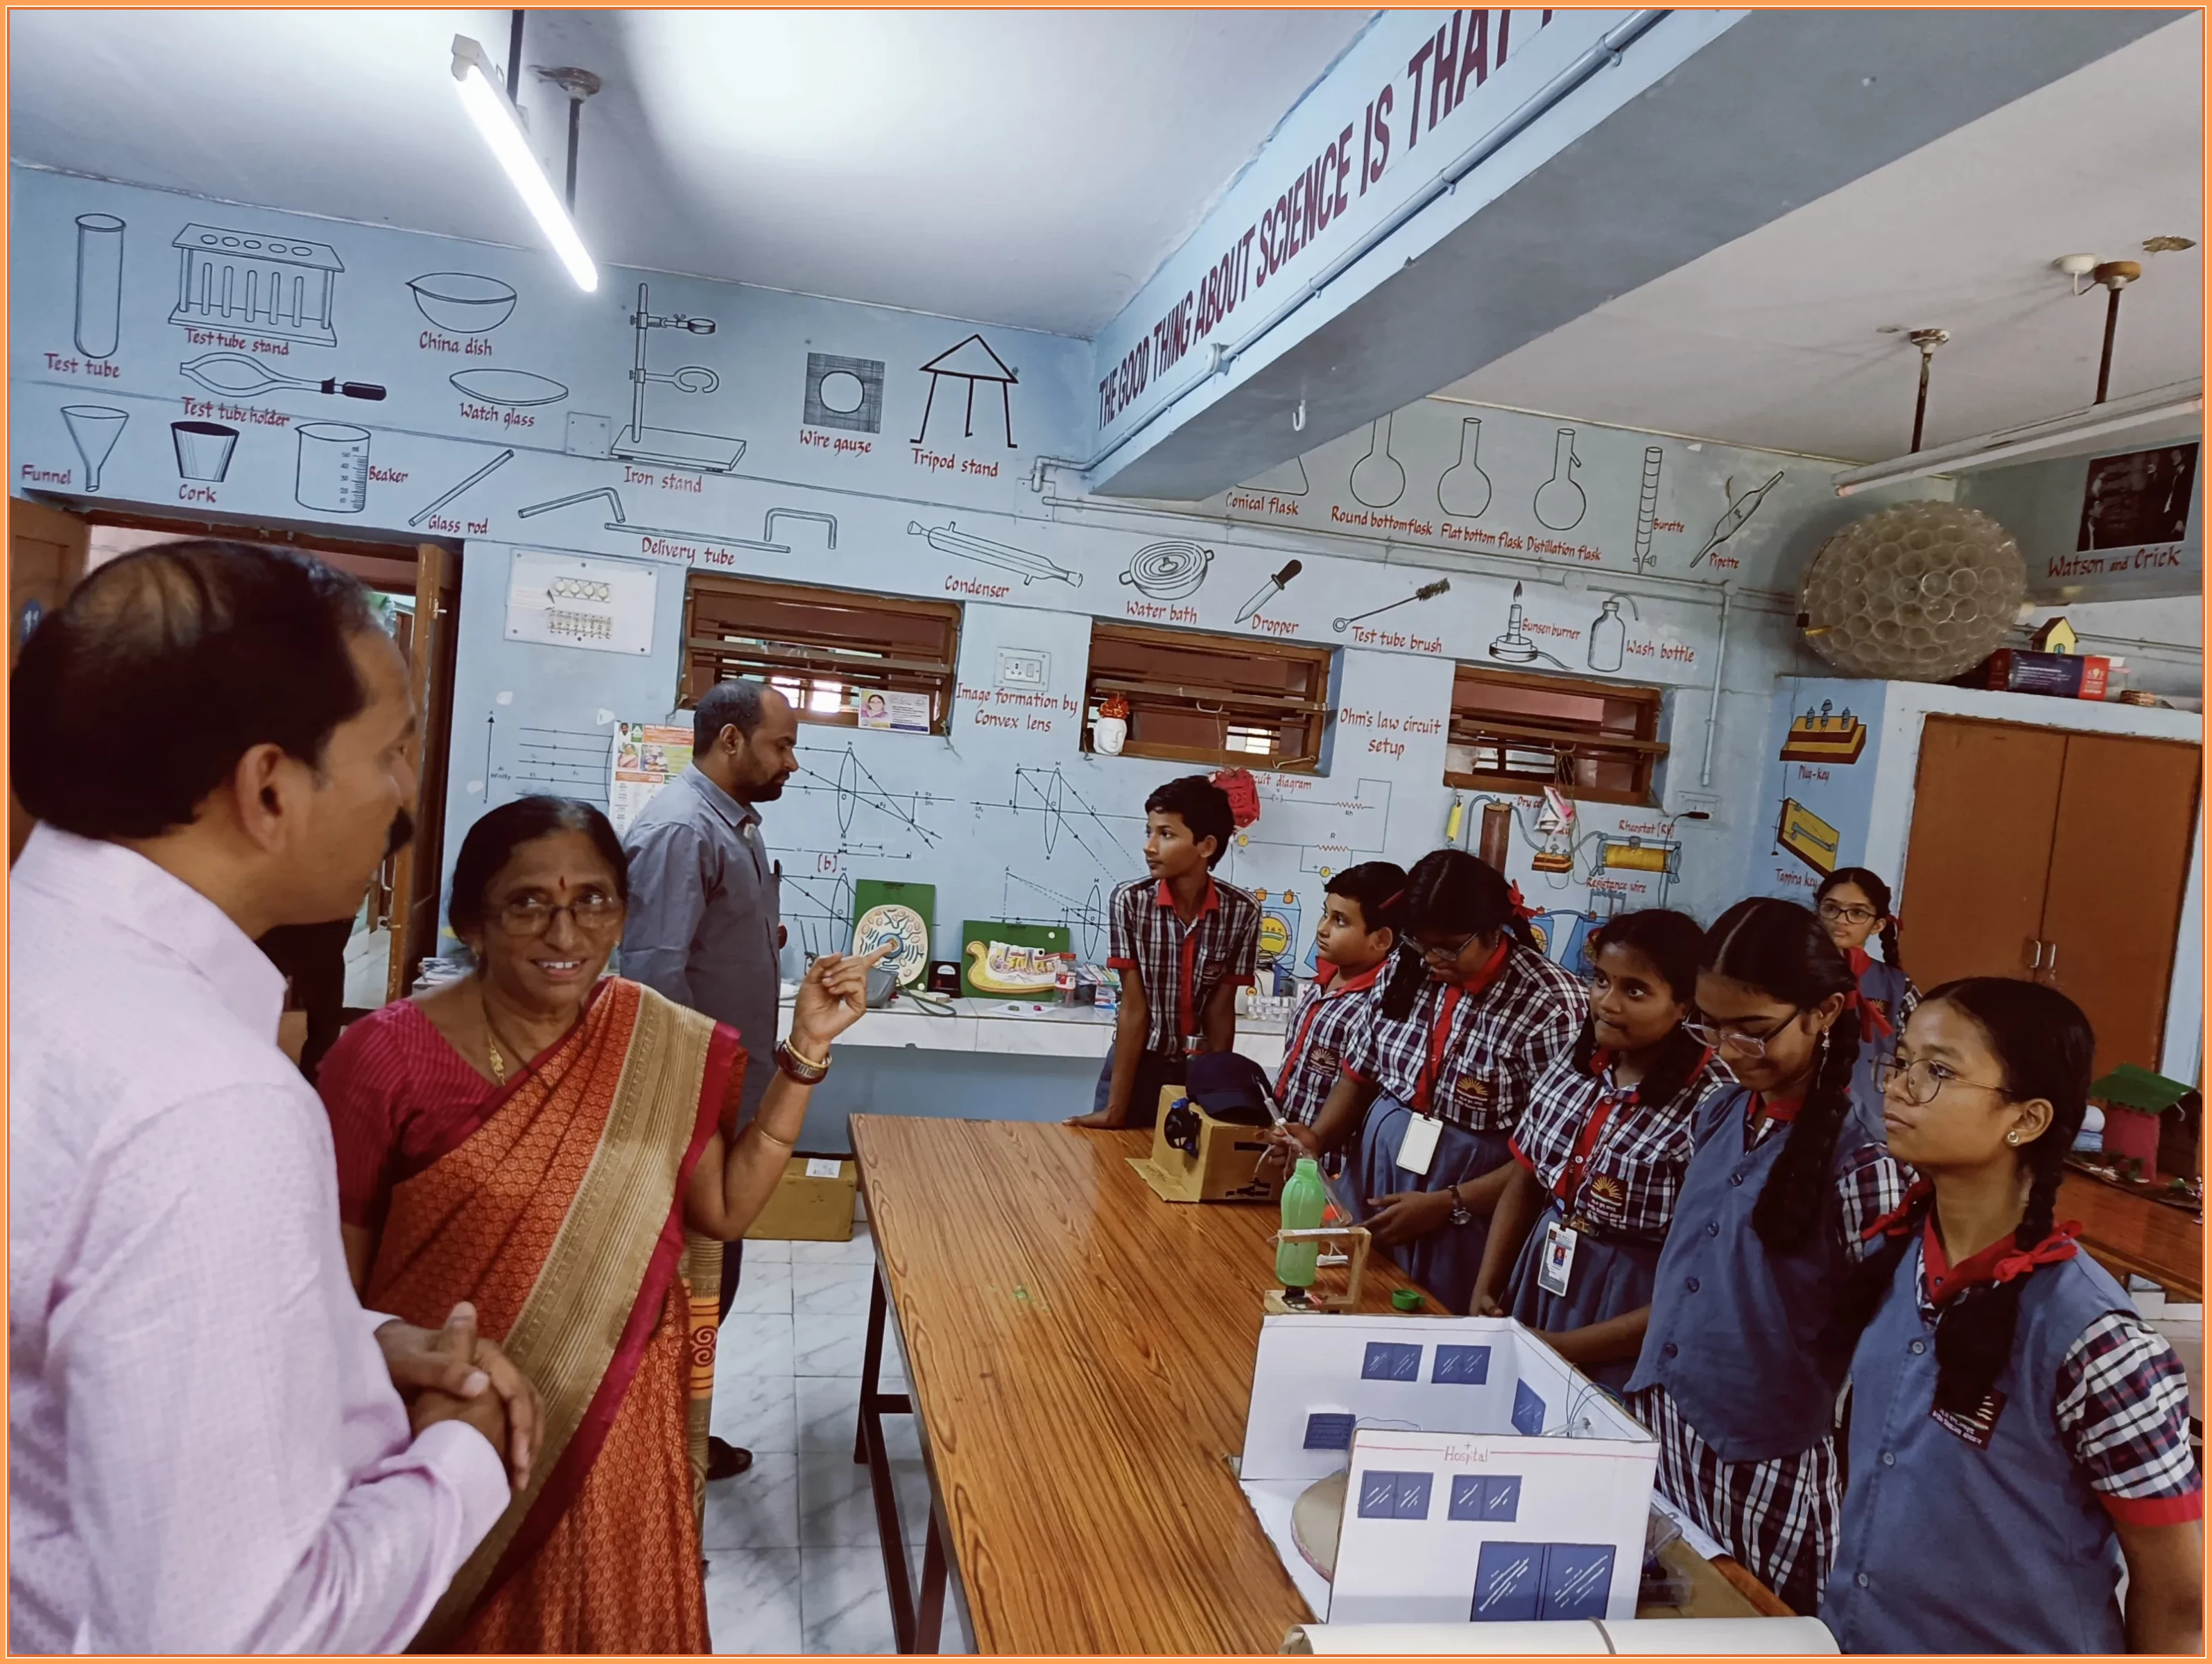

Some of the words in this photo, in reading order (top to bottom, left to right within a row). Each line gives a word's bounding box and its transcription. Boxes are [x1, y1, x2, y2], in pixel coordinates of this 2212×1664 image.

[1098, 367, 1119, 431] THE
[1119, 336, 1150, 414] GOOD
[1153, 290, 1193, 383] THING
[1193, 223, 1256, 346] ABOUT
[1256, 122, 1354, 288] SCIENCE
[1359, 84, 1393, 197] IS
[184, 327, 214, 345] Test
[216, 332, 245, 349] tube
[252, 336, 290, 356] stand
[420, 331, 460, 354] China
[465, 336, 492, 356] dish
[44, 354, 78, 374] Test
[85, 359, 121, 379] tube
[181, 397, 214, 418] Test
[459, 403, 498, 422] Watch
[504, 408, 535, 431] glass
[799, 429, 829, 449] Wire
[833, 437, 872, 457] gauze
[21, 464, 71, 485] Funnel
[368, 465, 408, 483] Beaker
[910, 448, 955, 474] Tripod
[961, 458, 998, 478] stand
[624, 466, 653, 485] Iron
[662, 473, 702, 494] stand
[179, 484, 216, 504] Cork
[1226, 492, 1265, 512] Conical
[1268, 496, 1300, 517] flask
[428, 515, 460, 533] Glass
[467, 518, 488, 535] rod
[1331, 505, 1368, 526] Round
[1653, 518, 1685, 533] Burette
[1441, 523, 1462, 539] Flat
[1464, 526, 1496, 545] bottom
[1498, 531, 1523, 550] flask
[1526, 536, 1575, 557] Distillation
[1578, 545, 1602, 561] flask
[641, 537, 695, 566] Delivery
[704, 547, 736, 566] tube
[1709, 553, 1739, 571] Pipette
[2048, 555, 2105, 578] Watson
[2109, 555, 2129, 572] and
[2134, 545, 2182, 569] Crick
[944, 574, 1010, 598] Condenser
[1126, 600, 1168, 622] Water
[1170, 603, 1198, 624] bath
[1251, 614, 1299, 636] Dropper
[1351, 627, 1378, 644] Test
[1380, 630, 1406, 648] tube
[1410, 632, 1442, 653] brush
[1627, 639, 1654, 657] Wash
[1661, 643, 1694, 663] bottle
[956, 682, 990, 708] Image
[994, 688, 1058, 710] formation
[1062, 694, 1078, 718] by
[974, 709, 1019, 729] Convex
[1027, 713, 1052, 732] lens
[1340, 707, 1373, 727] Ohm's
[1376, 713, 1399, 730] law
[1403, 716, 1442, 735] circuit
[1367, 736, 1406, 761] setup
[1277, 774, 1312, 794] diagram
[1517, 795, 1532, 813] Dry
[1586, 876, 1627, 890] Resistance
[1630, 880, 1647, 894] wire
[1775, 868, 1802, 889] Tapping
[1444, 1445, 1489, 1465] Hospital
